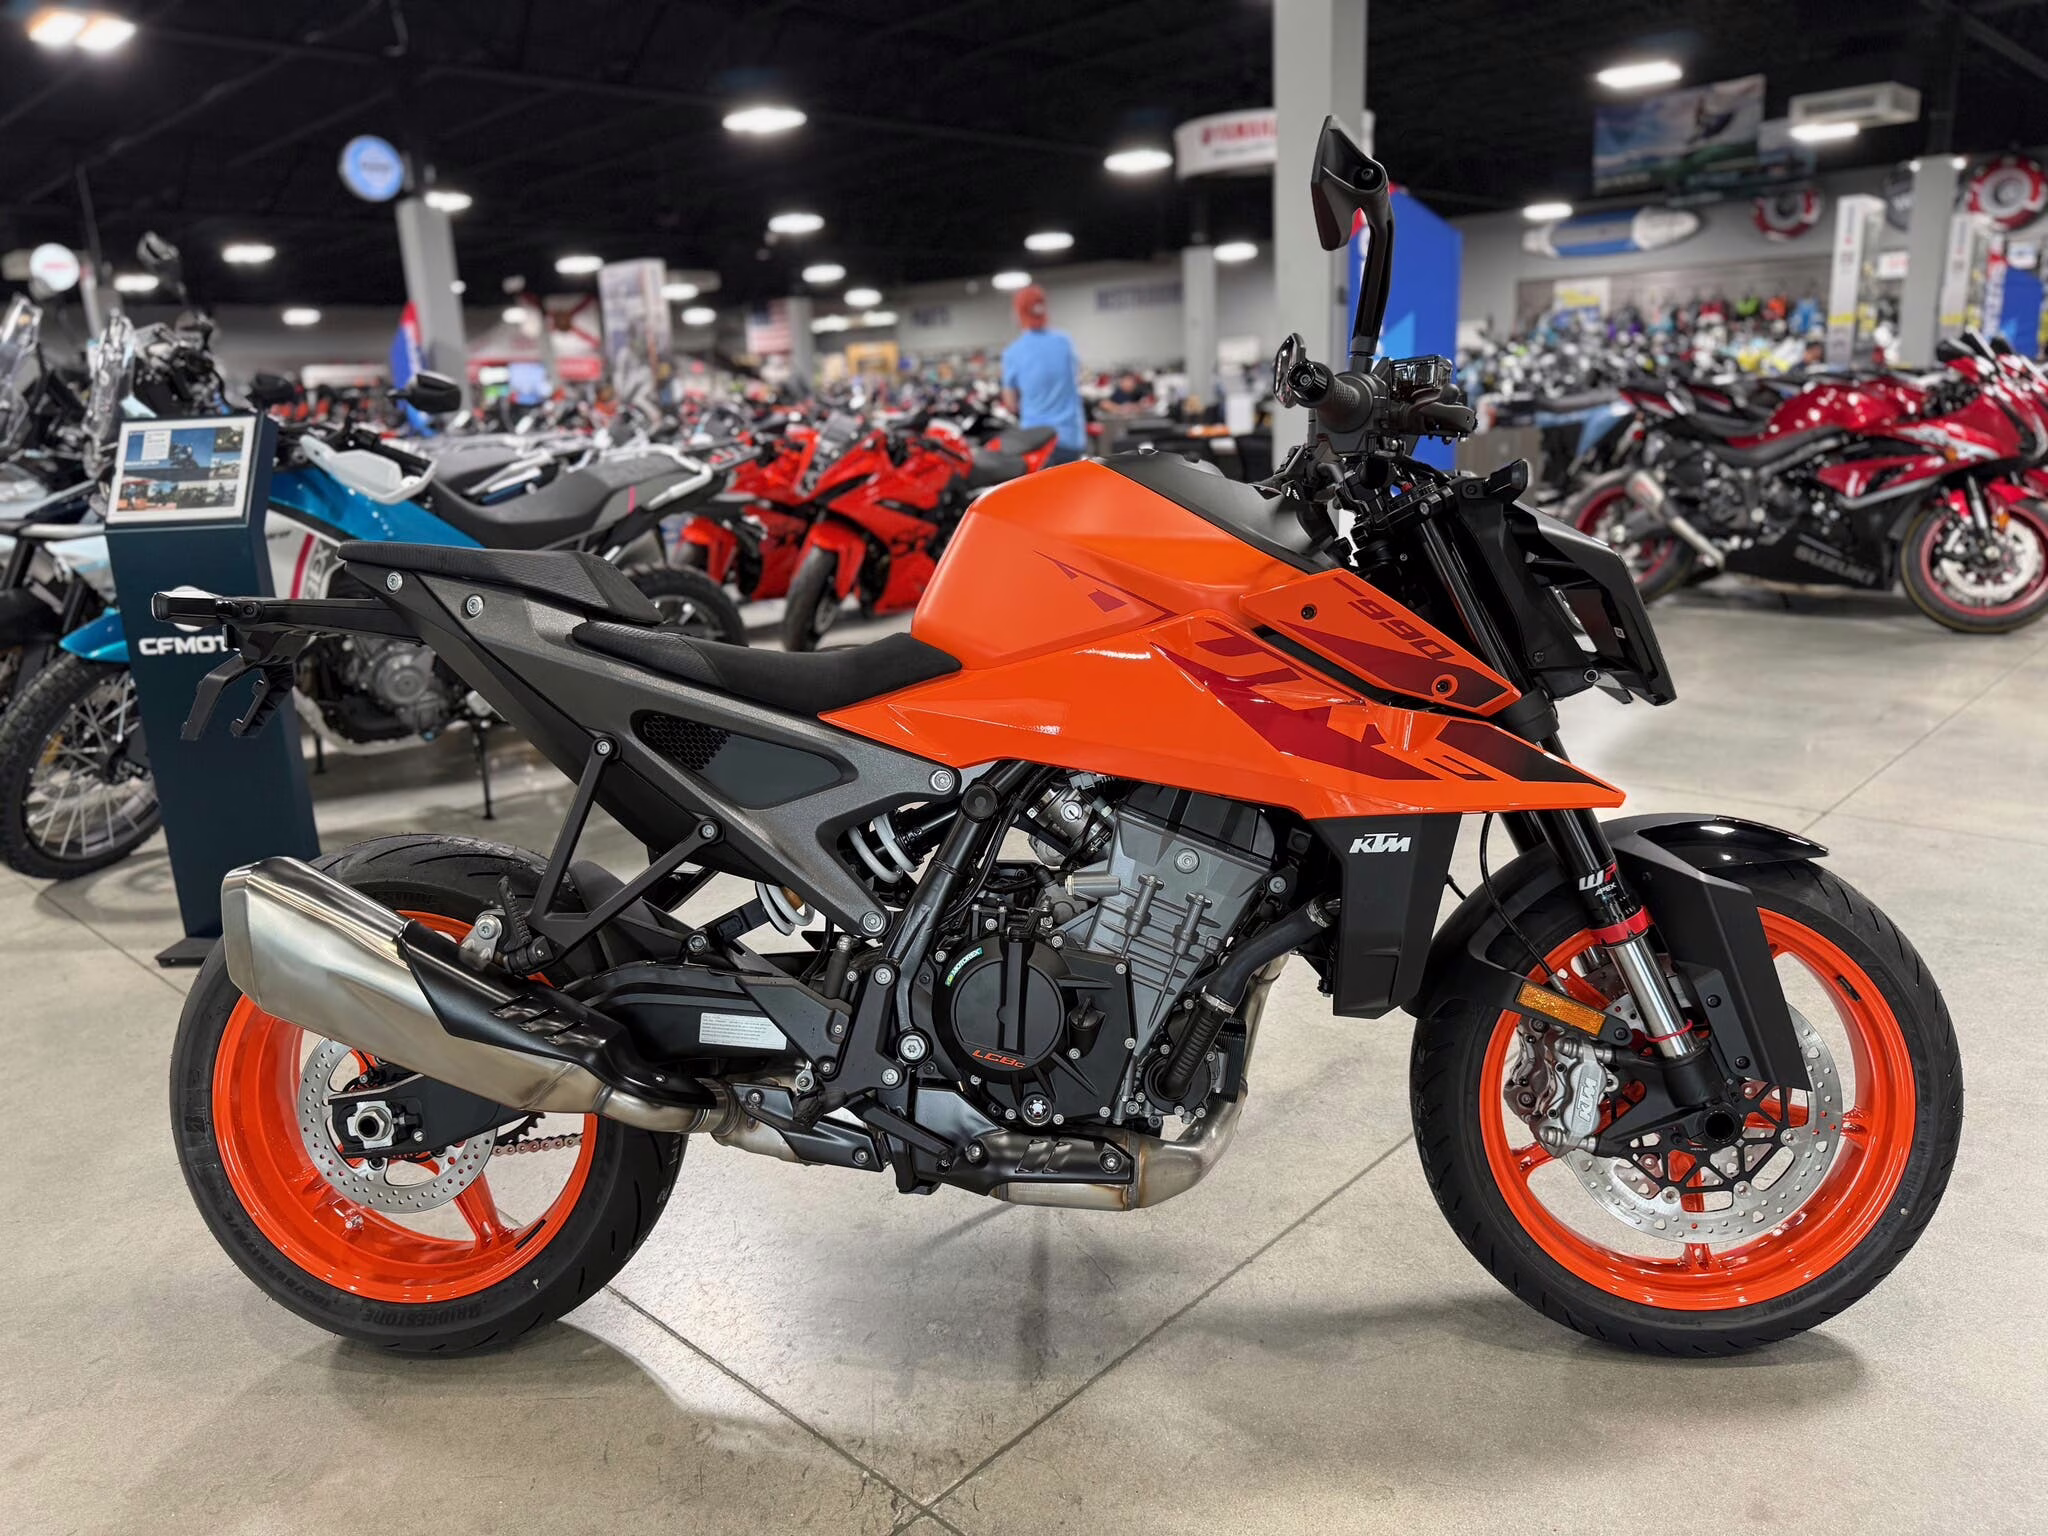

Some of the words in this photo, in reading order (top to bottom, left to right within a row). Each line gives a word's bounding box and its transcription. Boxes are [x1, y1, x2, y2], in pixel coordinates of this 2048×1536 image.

[1347, 598, 1455, 661] 990
[138, 635, 240, 656] CFMOT
[1349, 832, 1411, 854] KTM
[1579, 862, 1617, 891] WP
[1595, 882, 1617, 897] APEX
[1578, 1077, 1598, 1123] KTM
[362, 1303, 482, 1327] BRIDGESTONE
